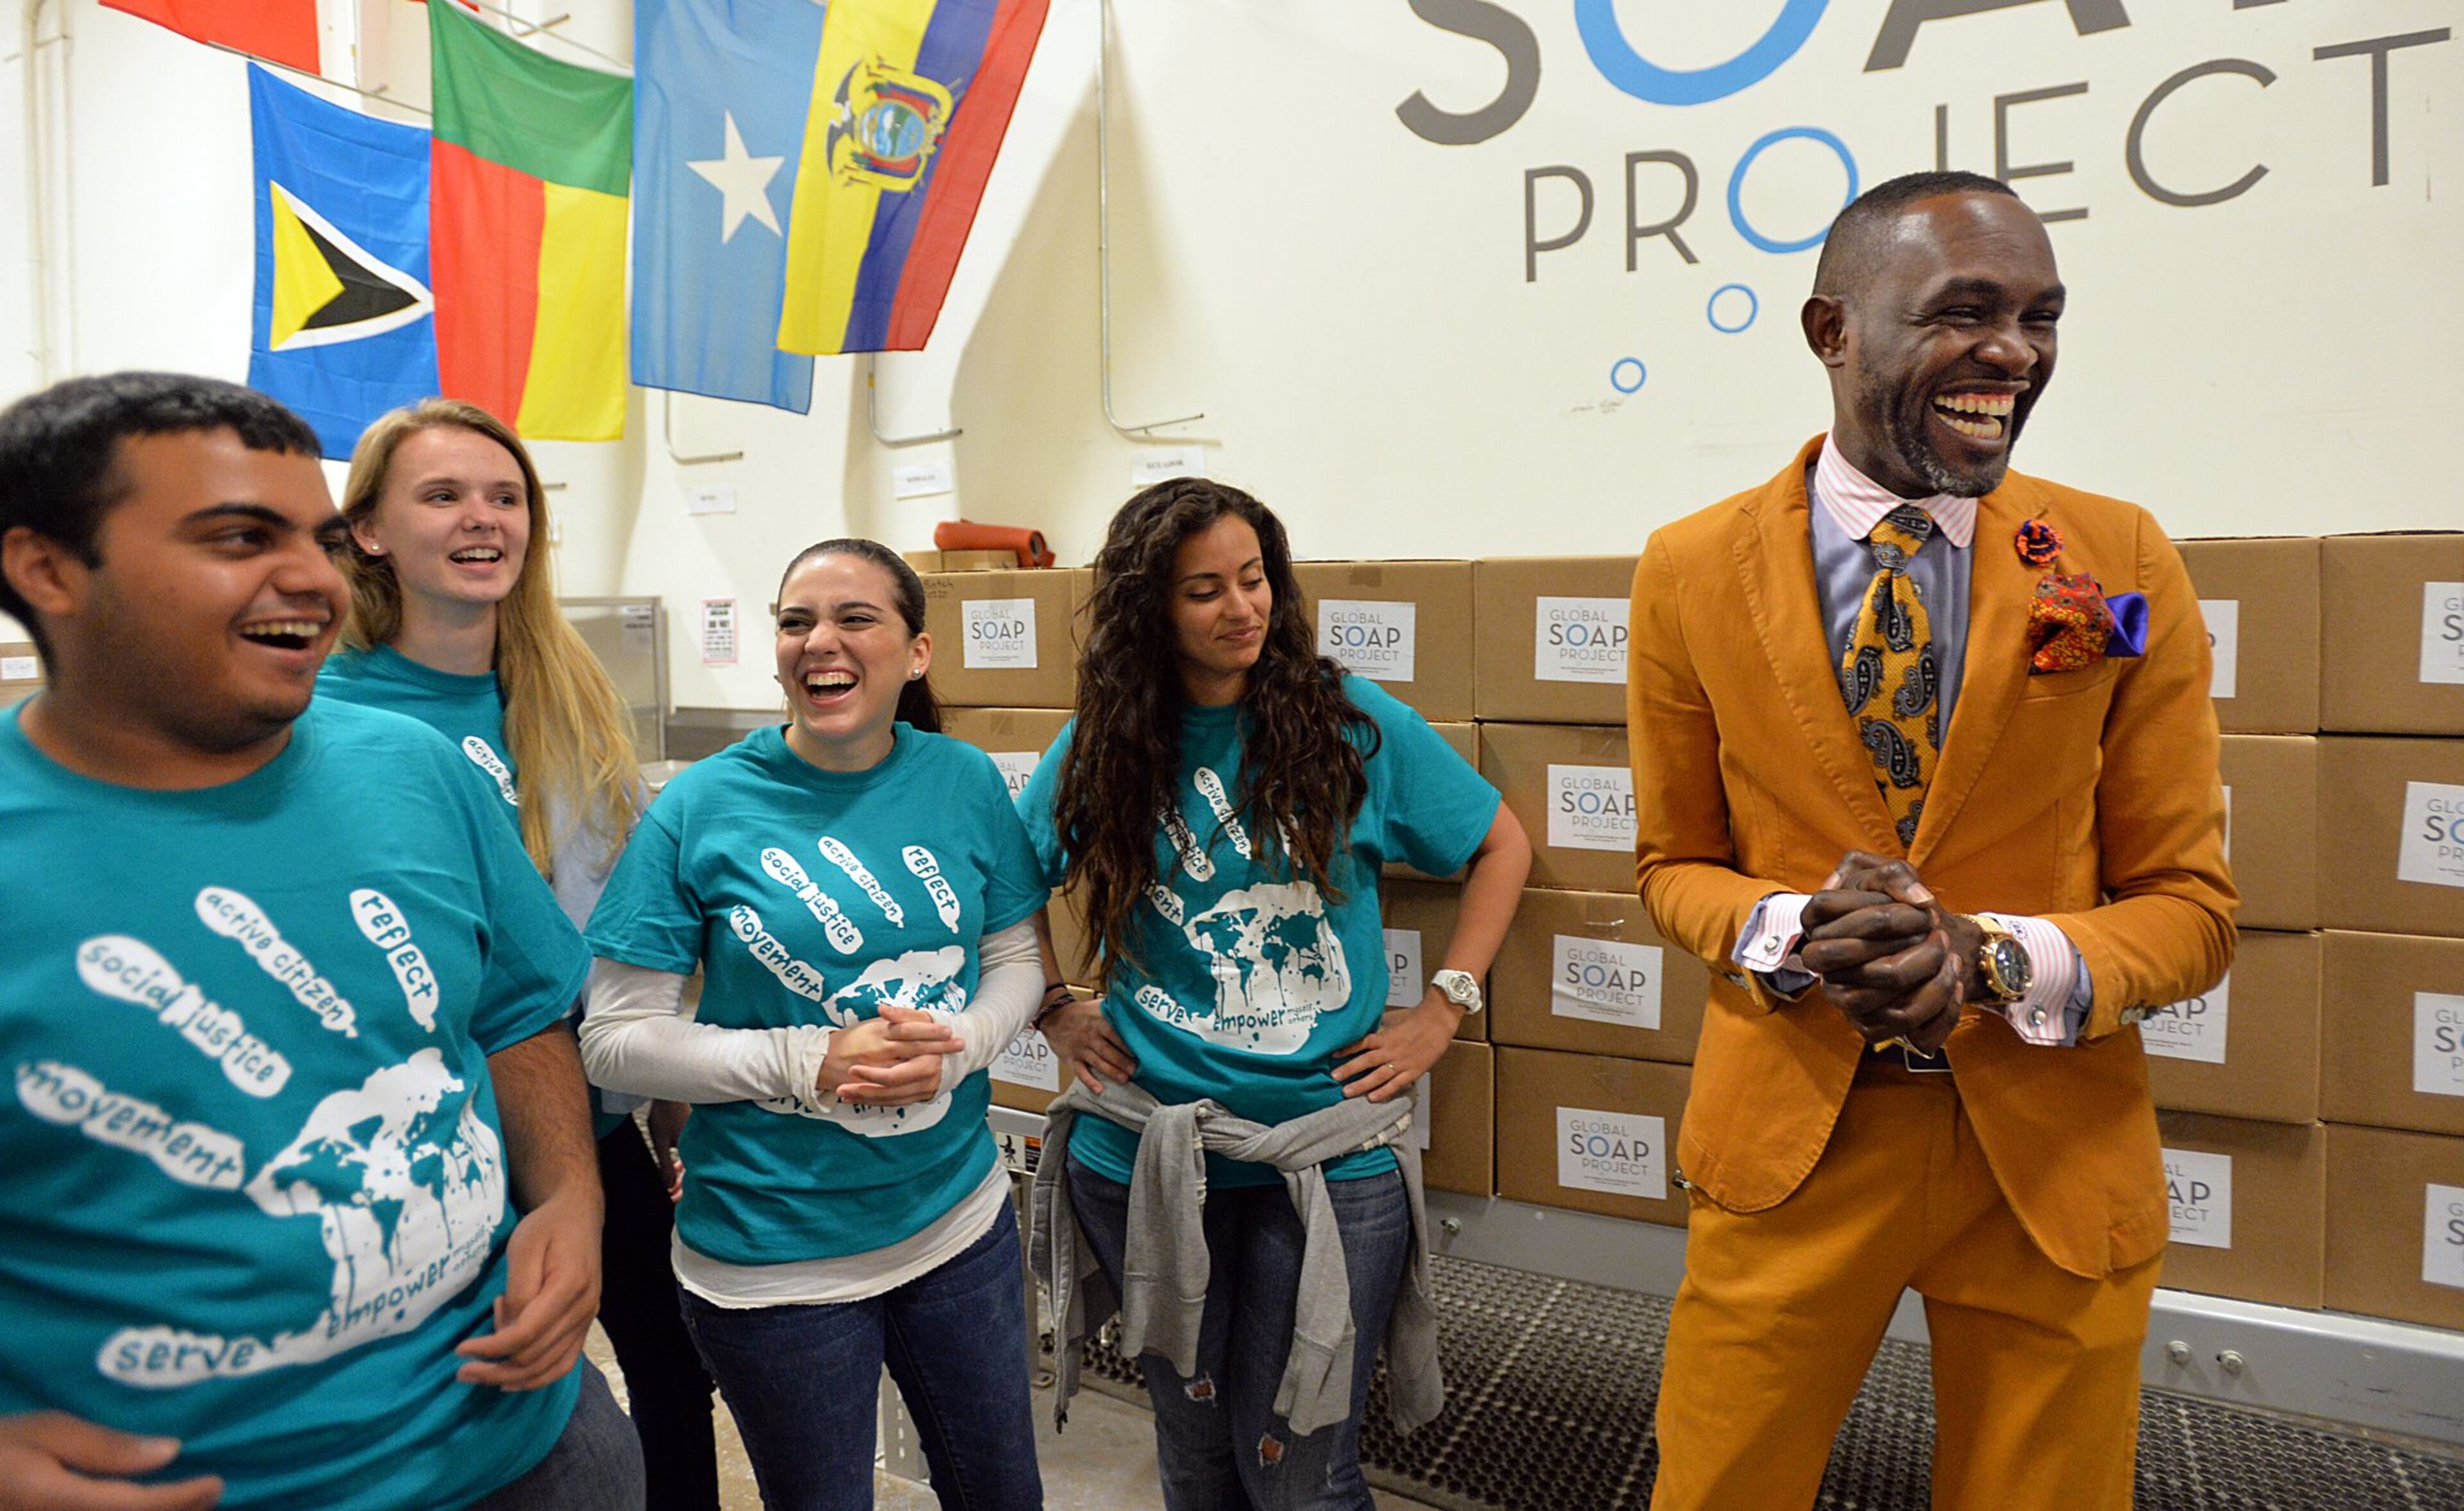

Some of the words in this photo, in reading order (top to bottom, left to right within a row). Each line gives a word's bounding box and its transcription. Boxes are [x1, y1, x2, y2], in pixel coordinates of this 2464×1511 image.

[971, 610, 1011, 620] GLOBAL
[1331, 611, 1383, 624] GLOBAL
[1550, 610, 1608, 622] GLOBAL
[971, 620, 1025, 639] SOAP
[1330, 625, 1401, 648] SOAP
[1549, 624, 1628, 647] SOAP
[980, 640, 1024, 651] PROJECT
[1340, 648, 1399, 662] PROJECT
[1560, 648, 1627, 662] PROJECT
[1199, 771, 1224, 806] active
[1561, 777, 1620, 791] GLOBAL
[824, 840, 859, 871] active
[859, 875, 898, 916] citizen
[909, 848, 955, 910] reflect
[764, 851, 810, 892] social
[803, 892, 855, 944] justice
[206, 894, 272, 950] active
[273, 953, 344, 1022] citizen
[361, 896, 432, 998] reflect
[735, 905, 820, 995] movement
[1568, 948, 1626, 966] GLOBAL
[1566, 962, 1645, 991] SOAP
[1577, 987, 1645, 1005] PROJECT
[84, 944, 184, 1009] social
[178, 1001, 275, 1082] justice
[1140, 990, 1185, 1023] serve
[1213, 1009, 1285, 1034] empower
[1007, 1039, 1048, 1061] OAP
[1003, 1055, 1047, 1073] PROJECT
[26, 1063, 238, 1182] movement
[1570, 1120, 1629, 1137] GLOBAL
[1571, 1133, 1649, 1162] SOAP
[1582, 1157, 1648, 1176] PROJECT
[115, 1338, 255, 1372] serve
[327, 1254, 450, 1340] empower
